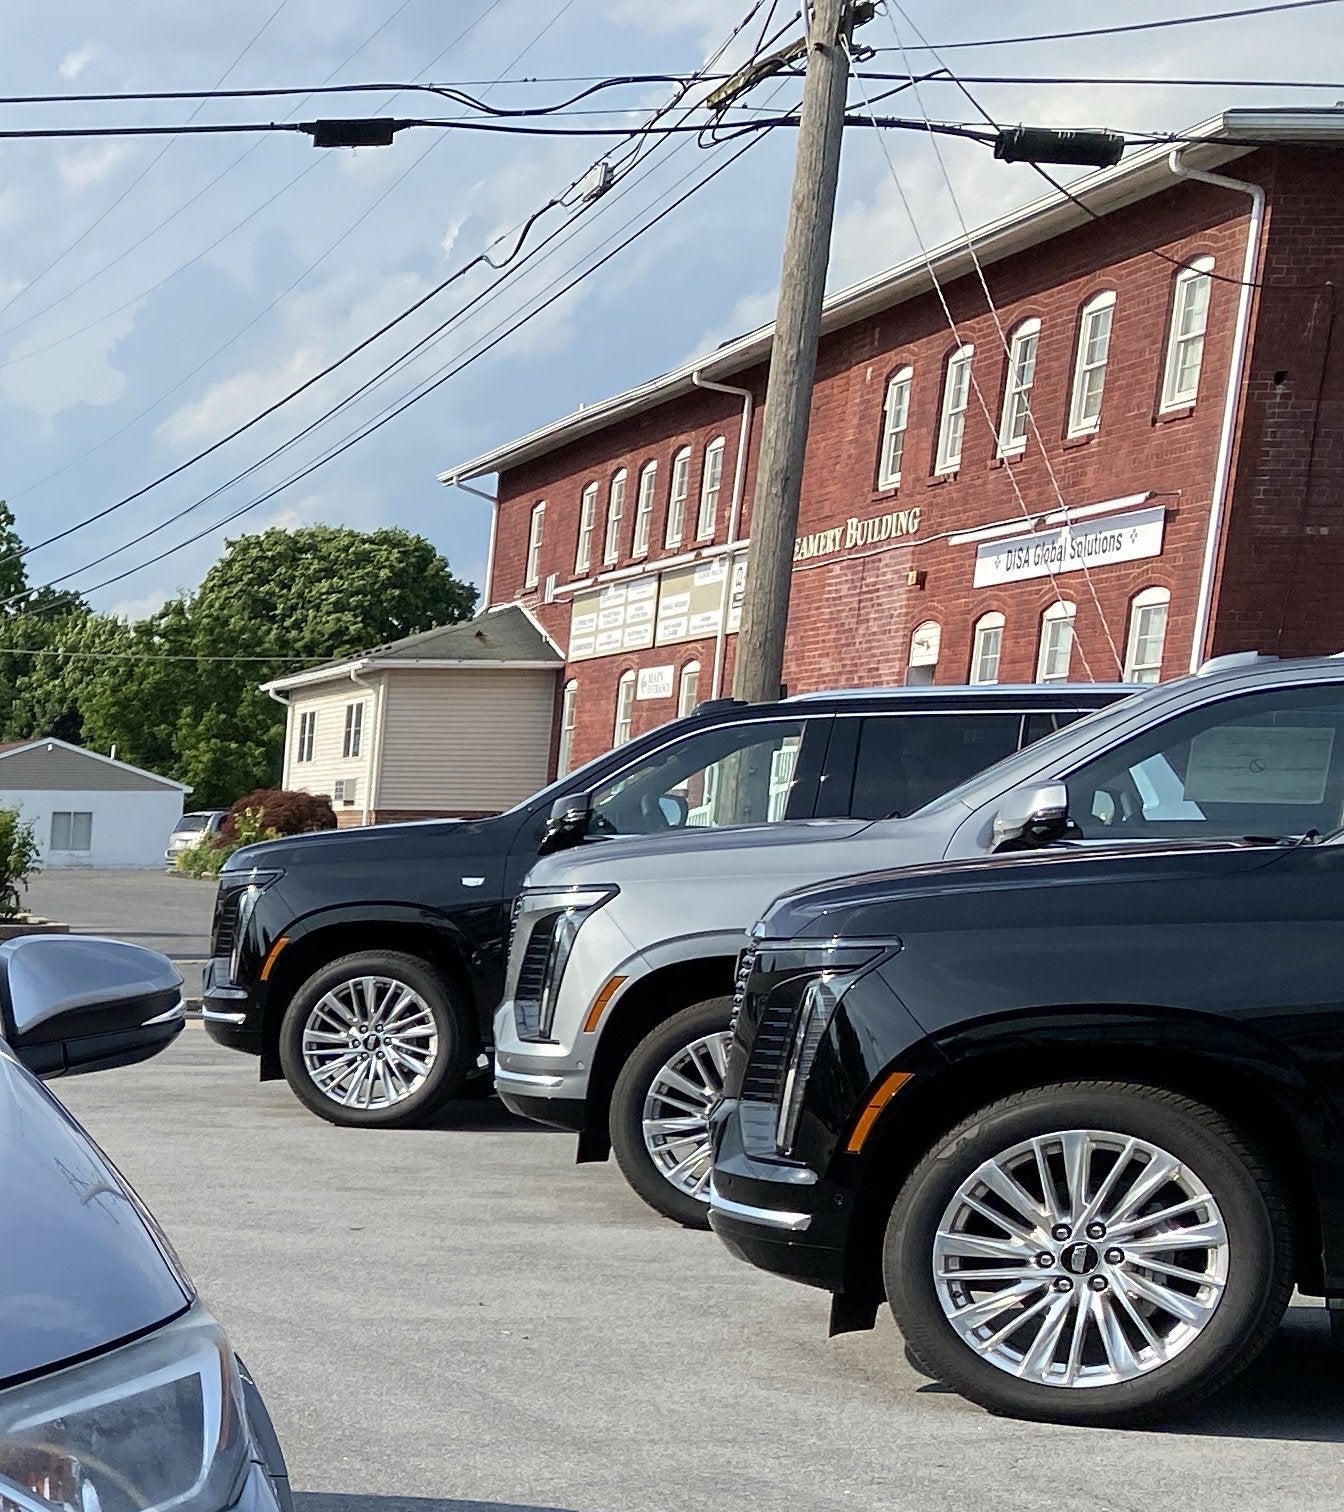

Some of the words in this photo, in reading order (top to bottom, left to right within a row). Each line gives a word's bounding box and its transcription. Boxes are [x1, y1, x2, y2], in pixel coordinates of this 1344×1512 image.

[845, 507, 920, 549] BUILDING
[1005, 545, 1030, 571] DISA
[1033, 537, 1067, 567] Global
[1070, 531, 1123, 560] Solutions
